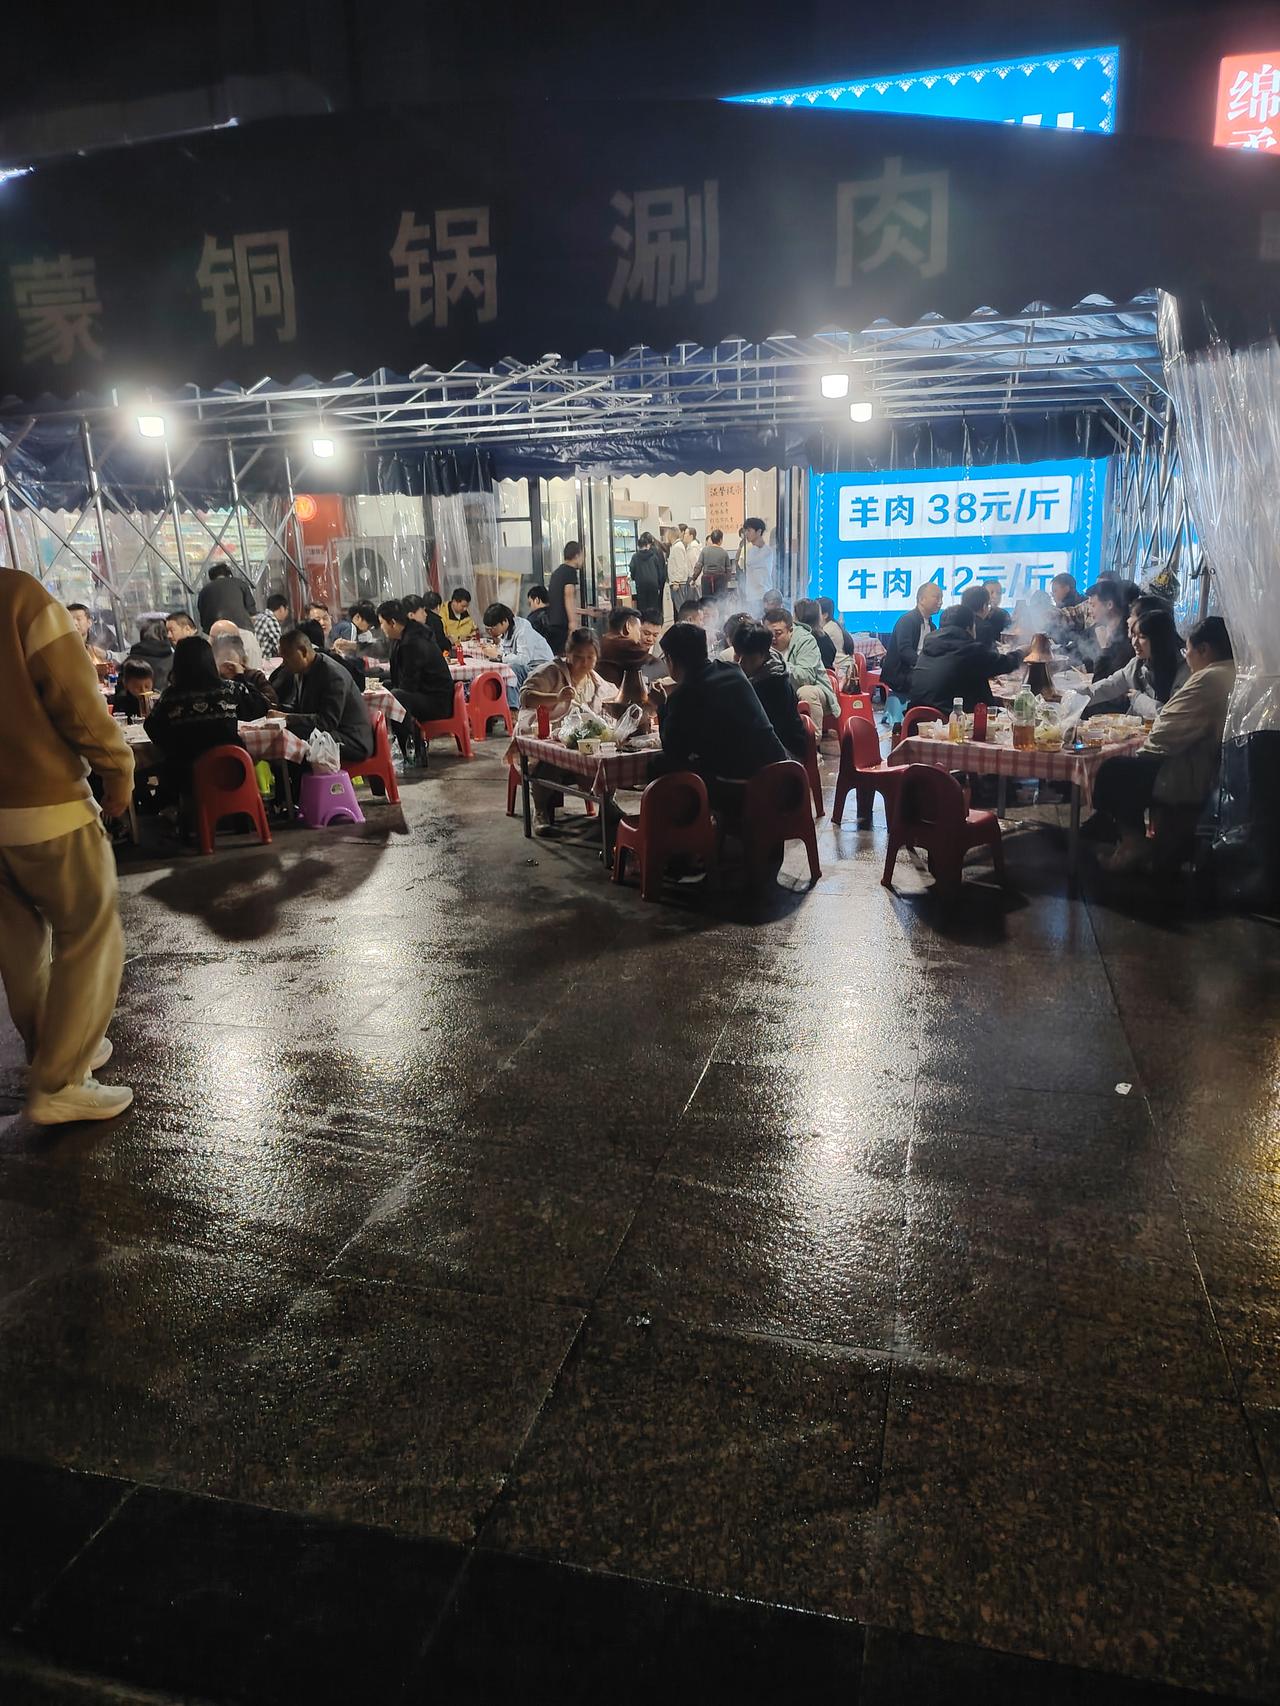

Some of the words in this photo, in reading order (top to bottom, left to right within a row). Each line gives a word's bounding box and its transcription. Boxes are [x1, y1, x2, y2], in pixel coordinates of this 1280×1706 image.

[9, 156, 951, 366] 蒙铜锅涮肉
[849, 494, 915, 528] 羊肉
[927, 488, 1060, 525] 38元/斤
[848, 567, 912, 599] 牛肉
